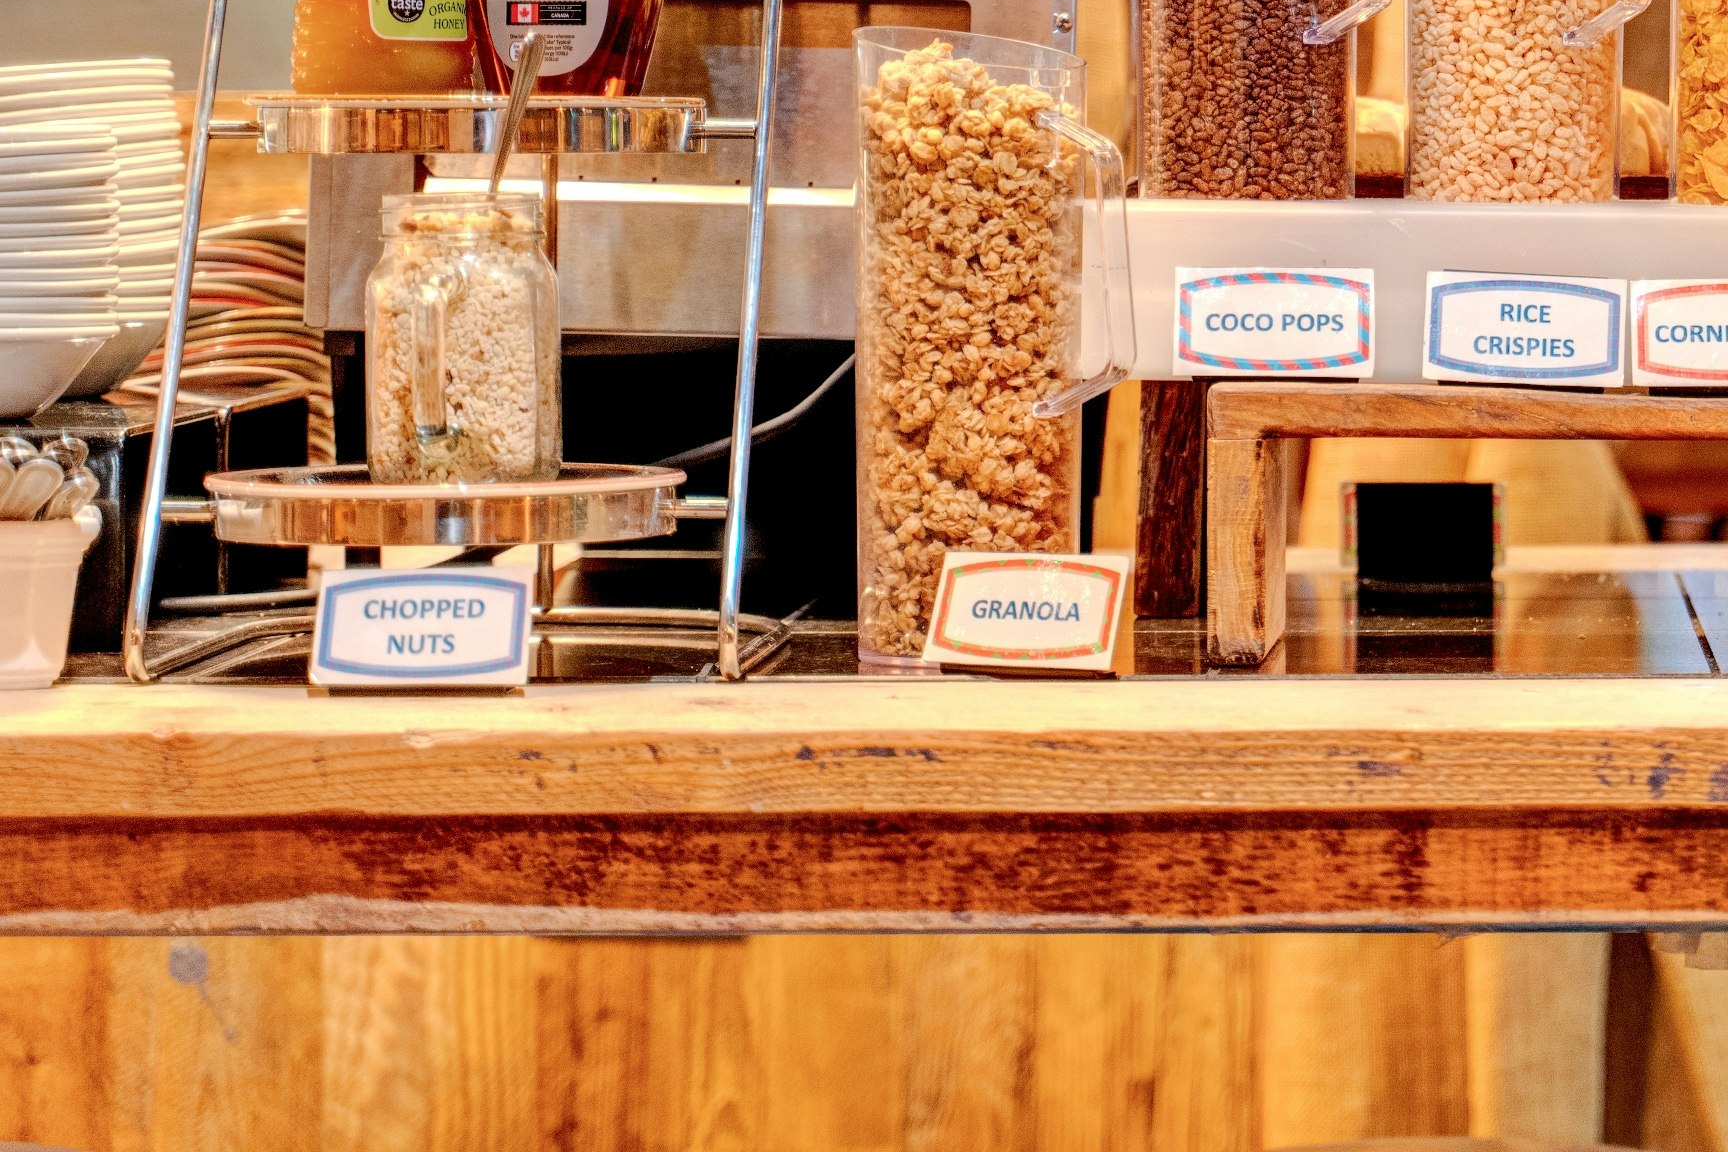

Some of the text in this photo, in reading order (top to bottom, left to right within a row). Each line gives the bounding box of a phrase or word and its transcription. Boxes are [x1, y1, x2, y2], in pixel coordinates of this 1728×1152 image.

[433, 18, 465, 30] HONEY
[1205, 313, 1344, 332] COCO POPS
[1499, 303, 1552, 324] RICE
[1472, 334, 1576, 358] CRISPIES
[363, 598, 486, 620] CHOPPED
[971, 599, 1081, 622] GRANOLA
[387, 634, 456, 655] NUTS
